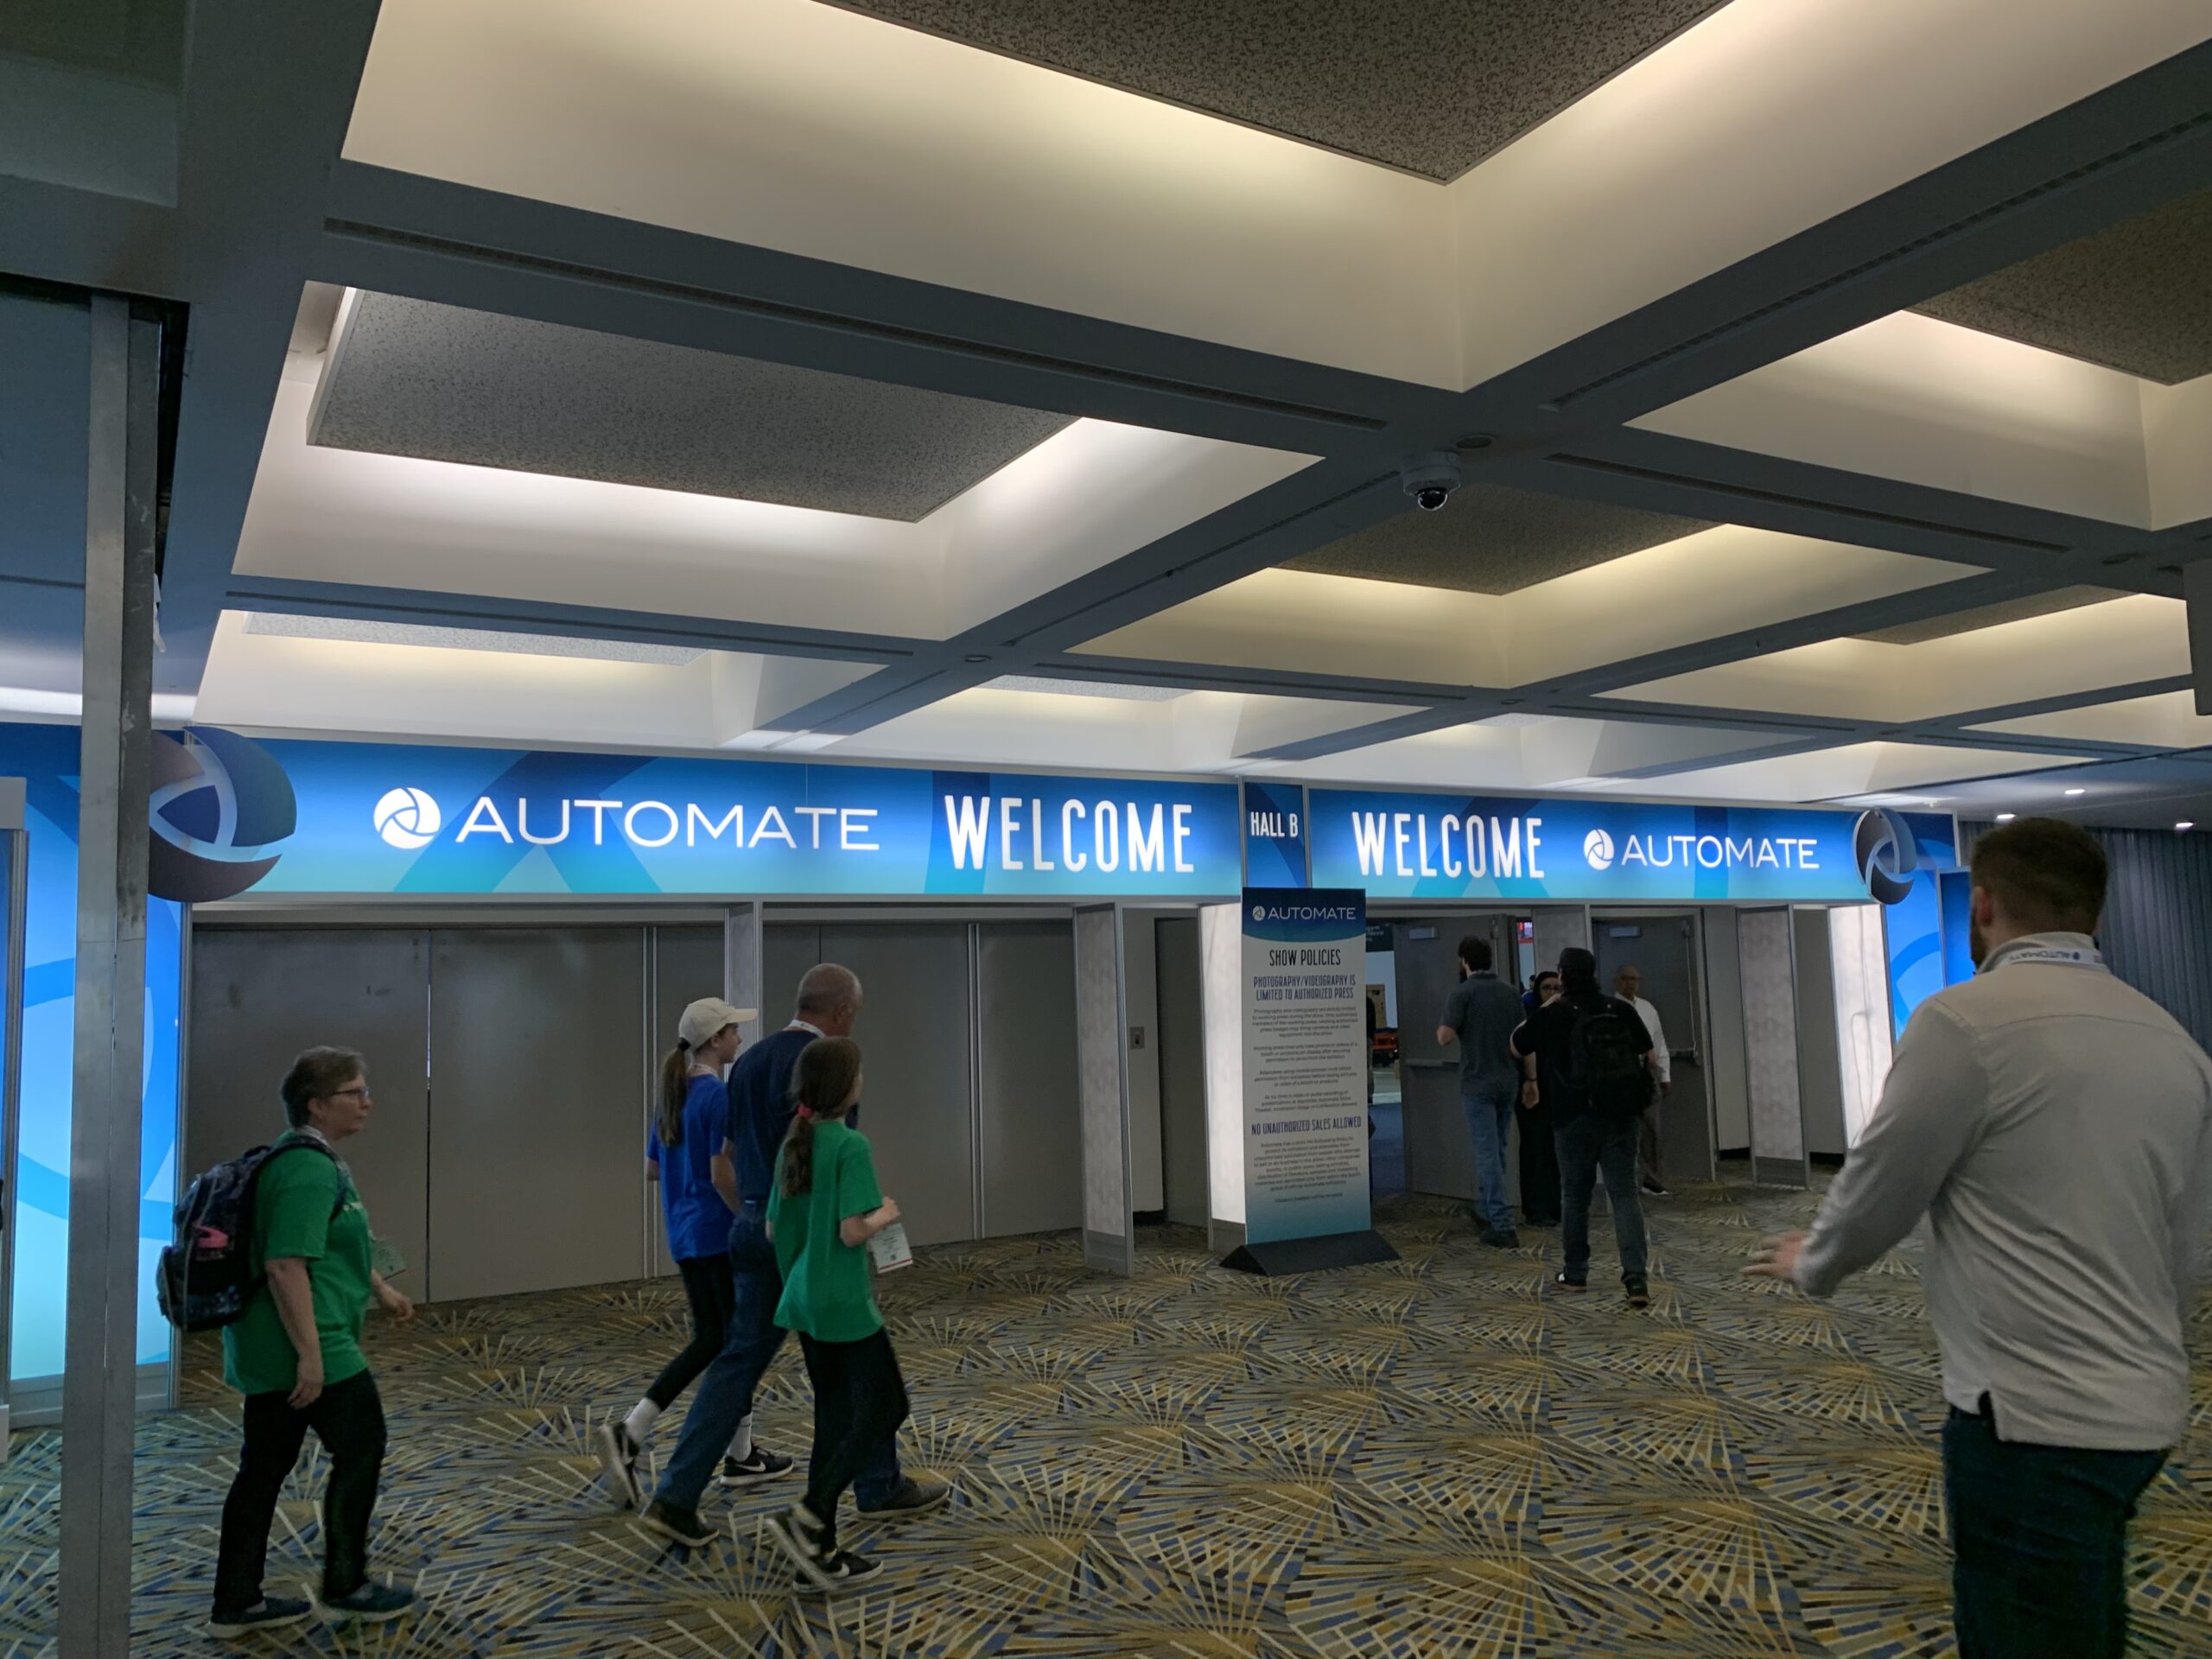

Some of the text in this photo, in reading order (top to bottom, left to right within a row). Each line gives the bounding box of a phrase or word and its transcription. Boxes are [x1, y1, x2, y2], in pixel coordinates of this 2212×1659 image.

[454, 796, 880, 851] AUTOMATE
[944, 795, 1194, 873] WELCOME
[1250, 811, 1299, 837] HALL B
[1351, 811, 1545, 879] WELCOME
[1621, 834, 1820, 869] AUTOMATE
[1268, 906, 1357, 920] AUTOMATE
[1269, 948, 1341, 966] SHOW POLICIES
[1254, 974, 1356, 988] PHOTOGRAPHY/VIDEOGRAPHY IS
[1256, 987, 1354, 1001] LIMITED TO AUTHORIZED PRESS
[1251, 1116, 1361, 1135] NO UNAUTHORIZED SALES ALLOWED
